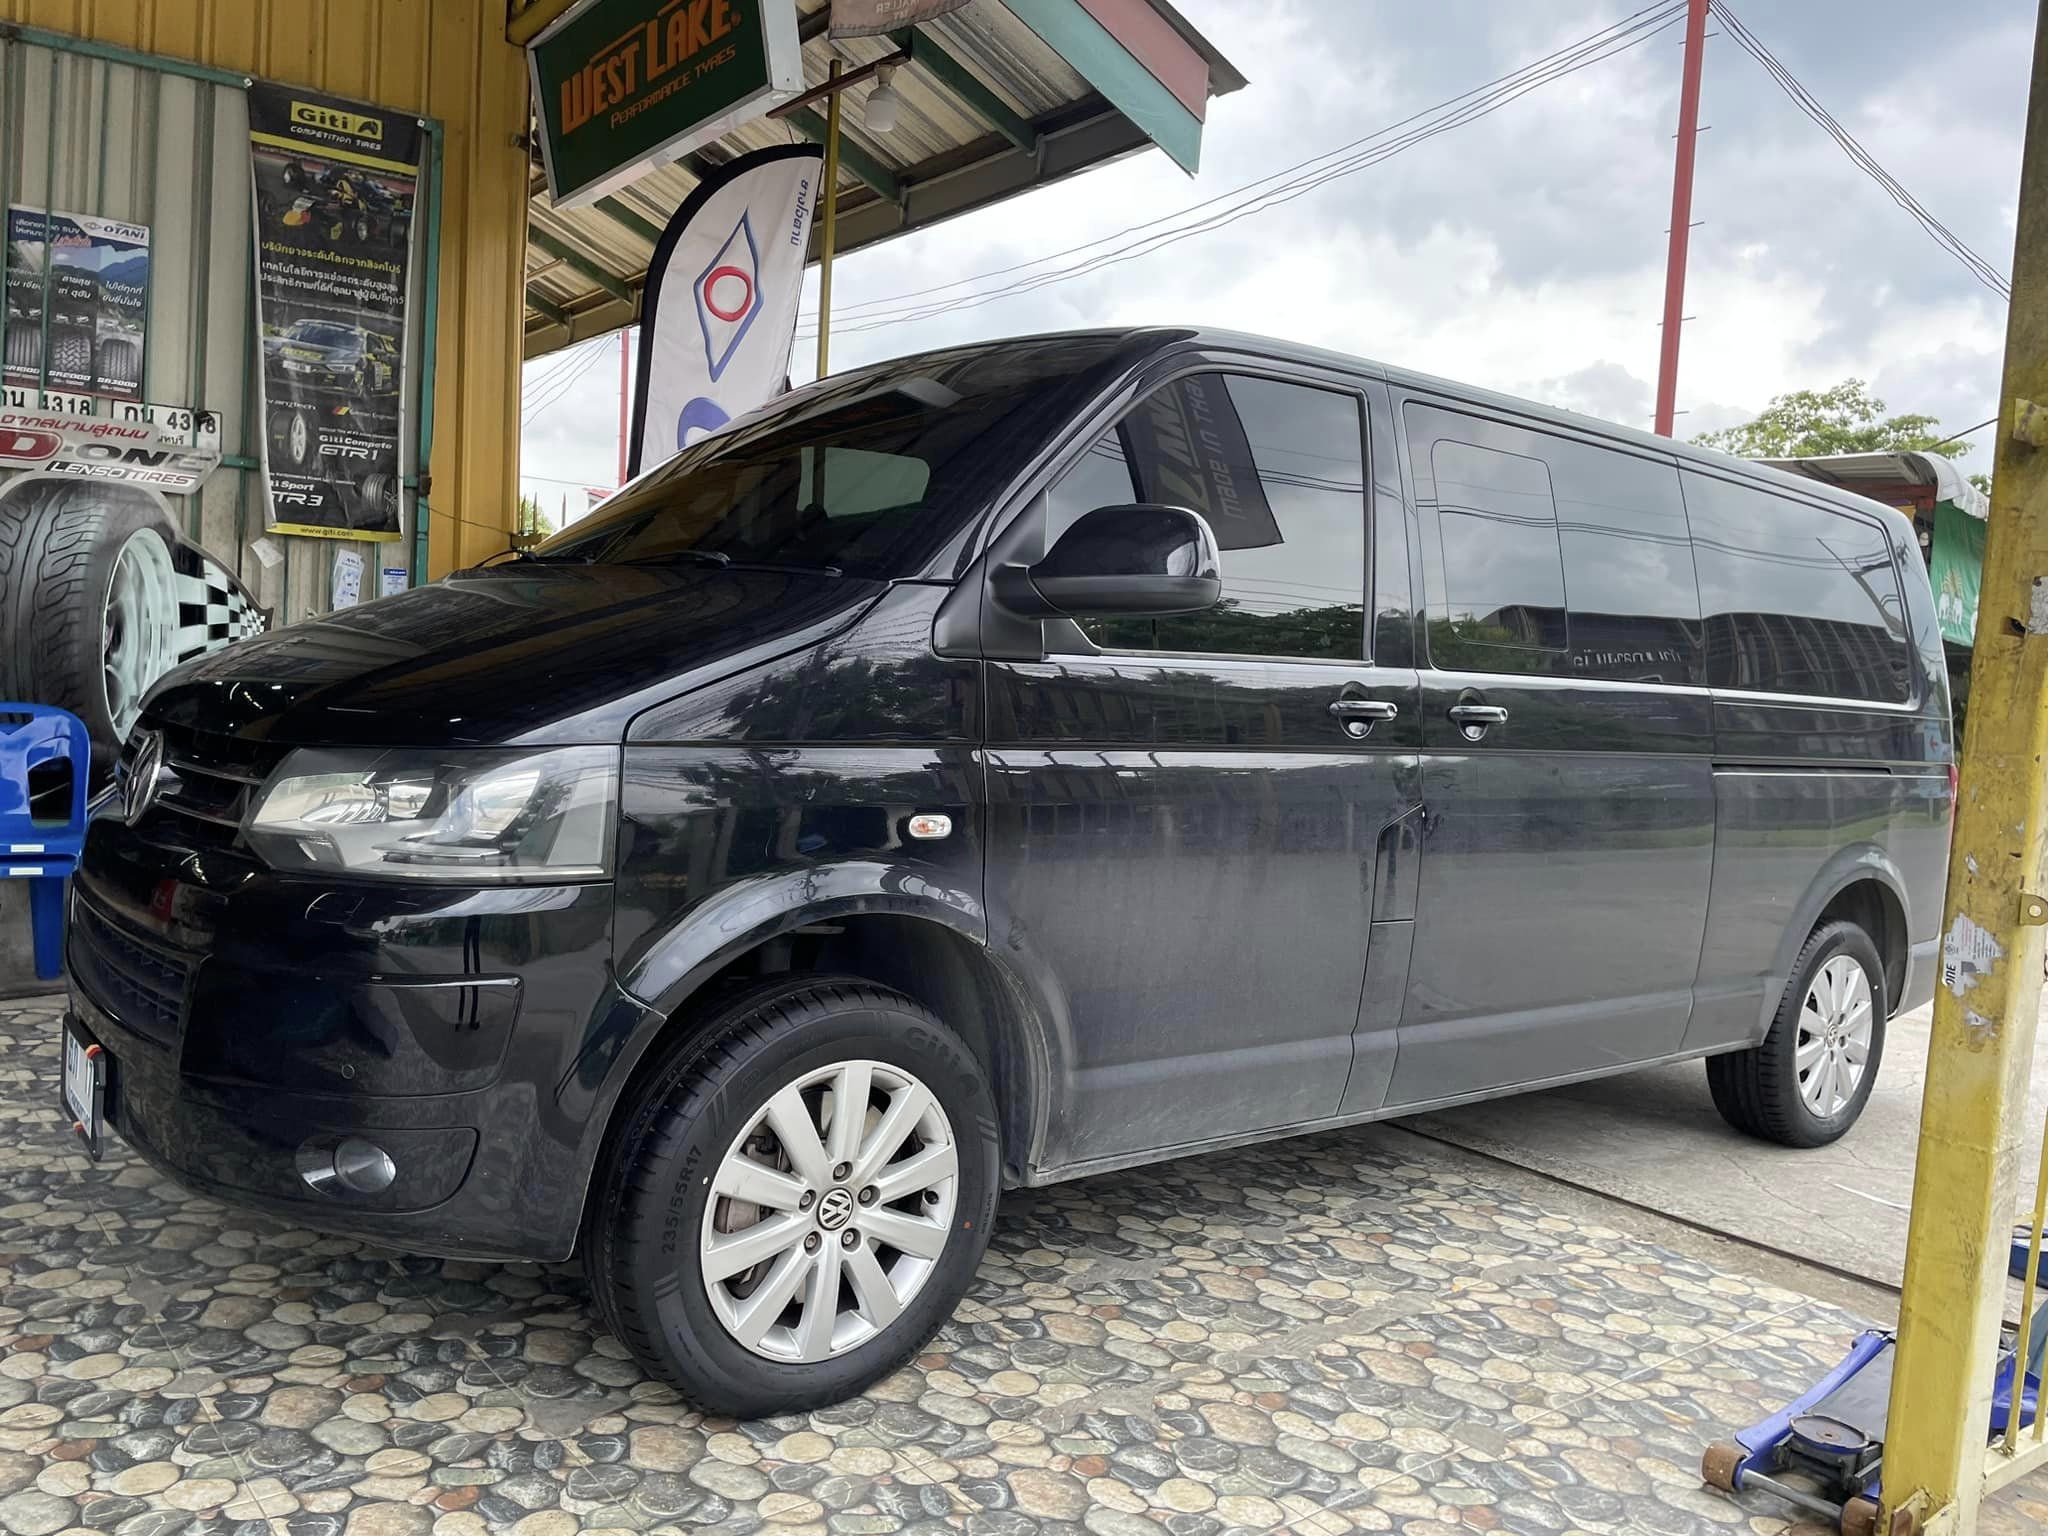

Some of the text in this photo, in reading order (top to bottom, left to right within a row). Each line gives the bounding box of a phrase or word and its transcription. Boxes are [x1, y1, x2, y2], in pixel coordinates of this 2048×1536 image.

[561, 0, 732, 135] WEST LAKE
[611, 44, 736, 129] PERFORMANCE TYRES
[297, 107, 348, 129] Giti
[103, 224, 145, 239] OTANI
[344, 437, 393, 449] Compete
[49, 461, 197, 487] LENSO TIRES
[281, 480, 315, 492] Sport
[661, 1143, 703, 1255] 235/55R17
